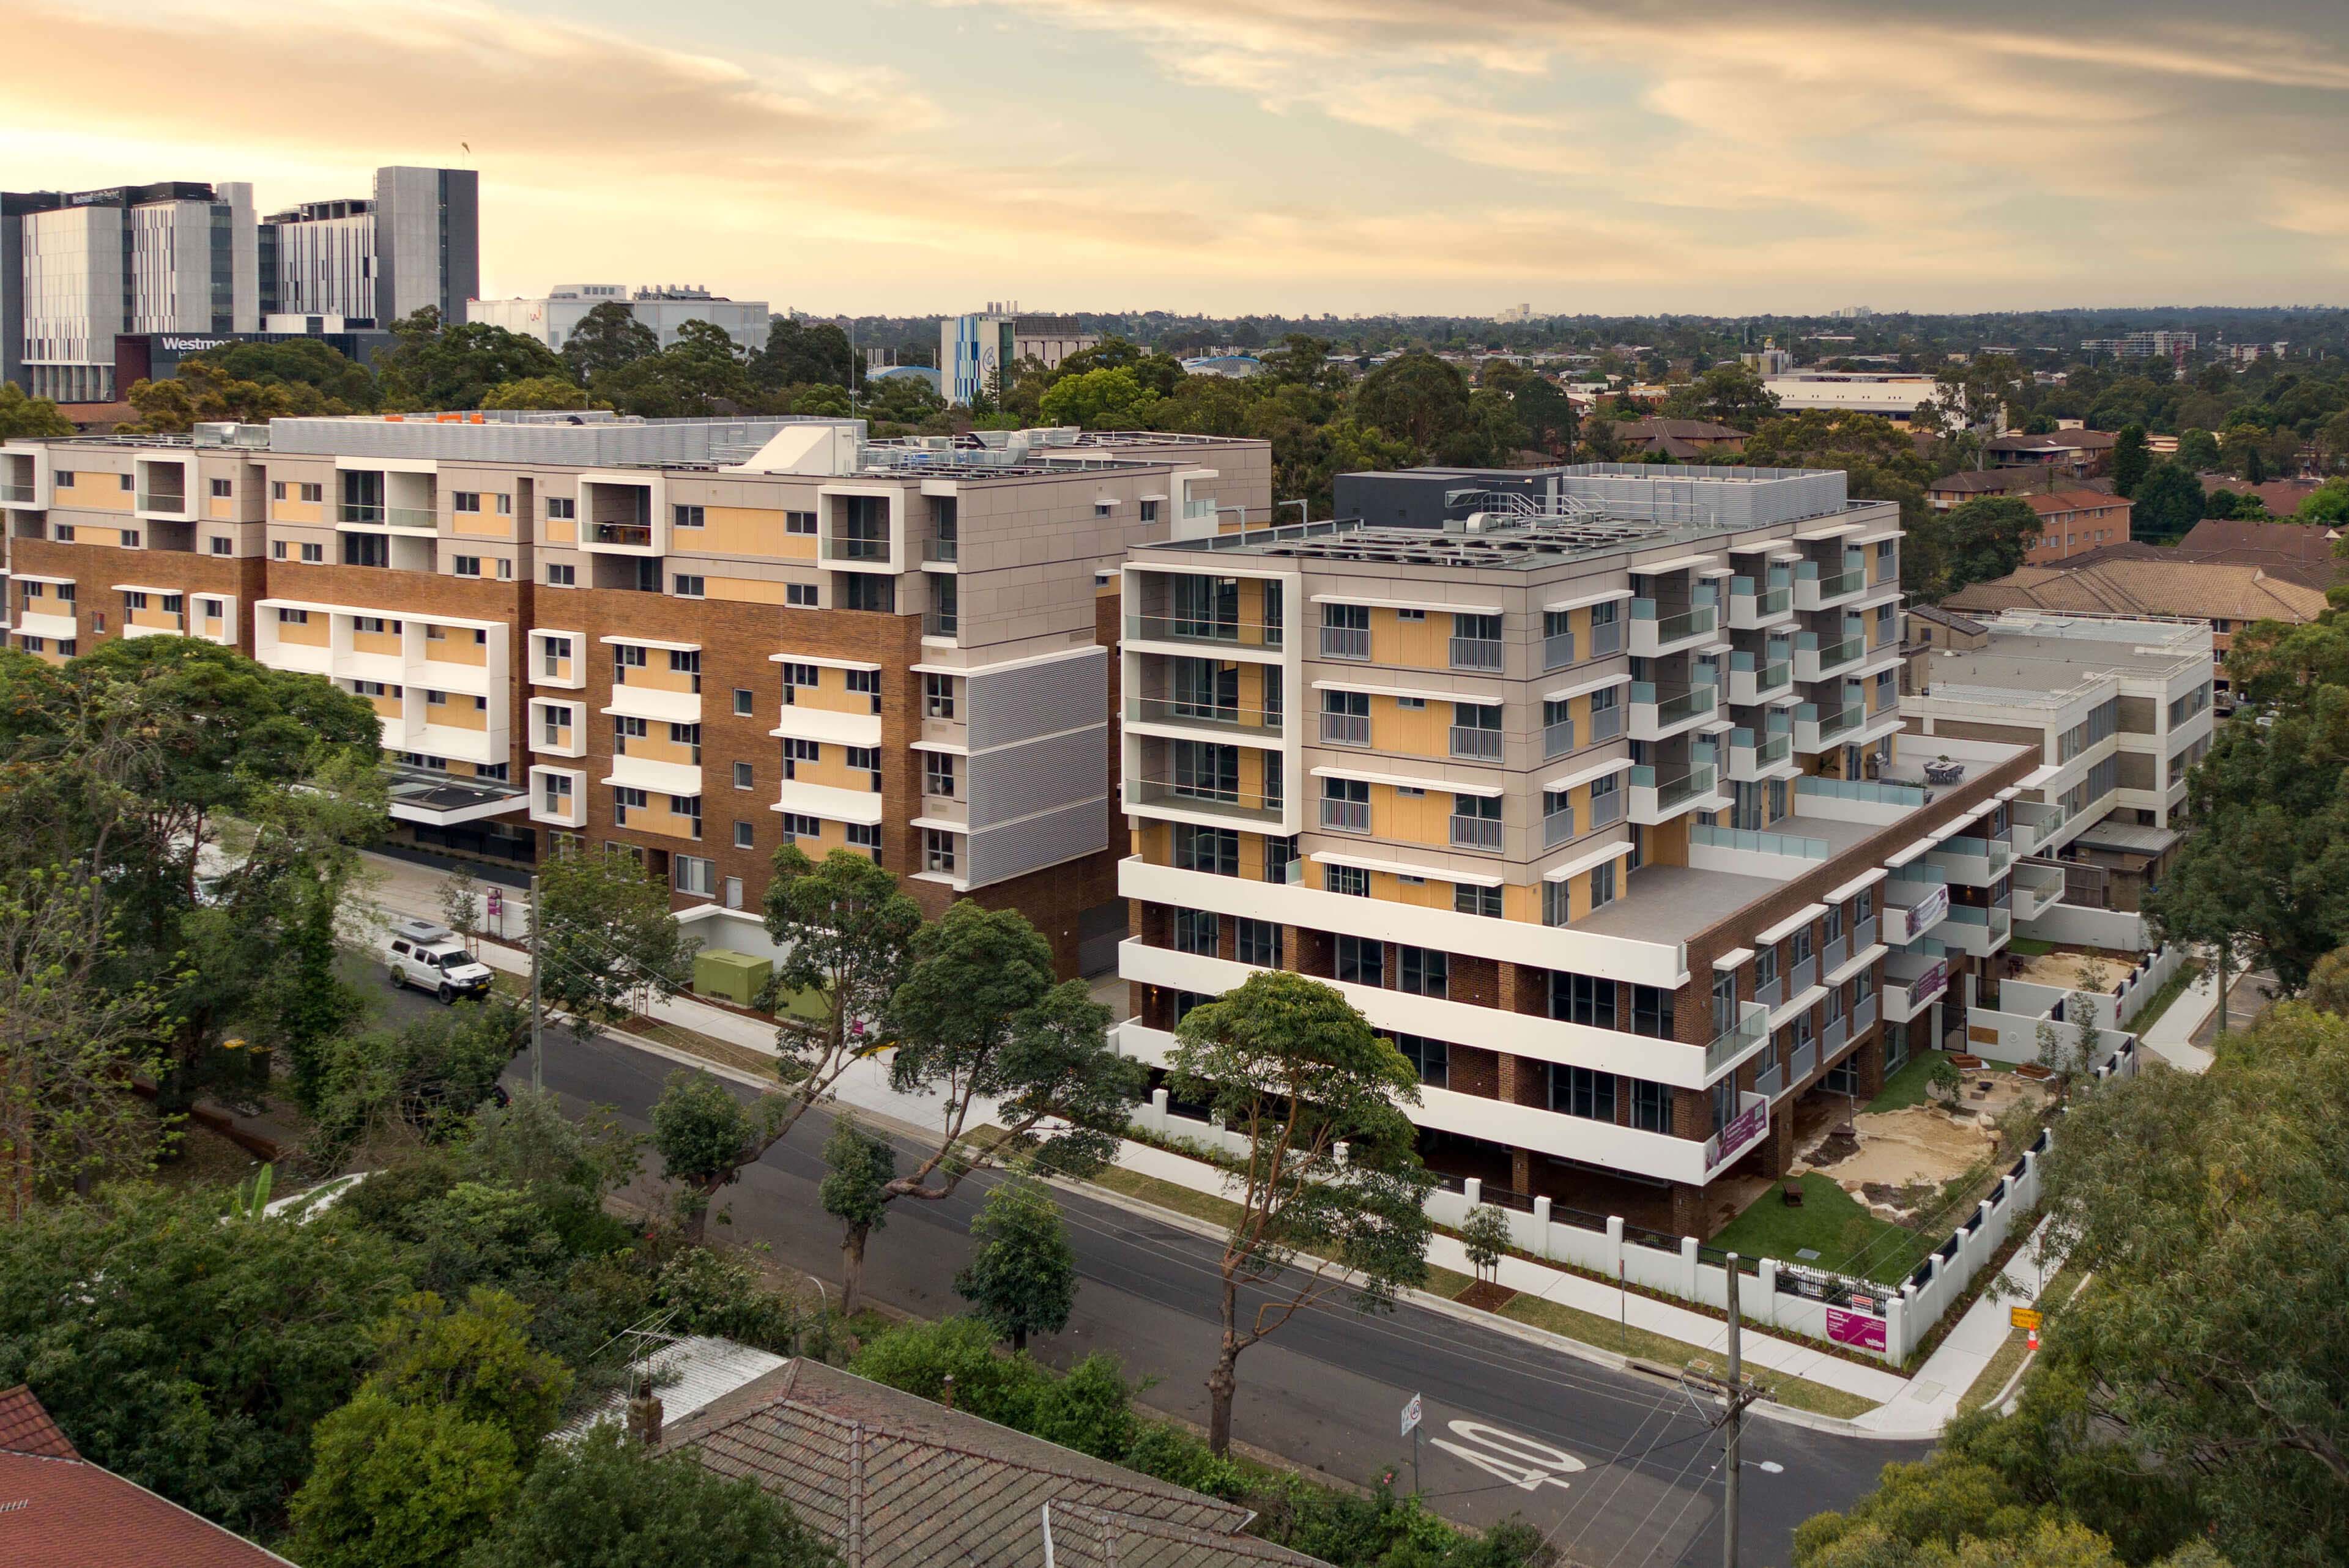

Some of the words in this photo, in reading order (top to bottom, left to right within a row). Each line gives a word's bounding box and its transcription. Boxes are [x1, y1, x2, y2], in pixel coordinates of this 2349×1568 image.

[162, 337, 243, 350] Westme
[1412, 1403, 1420, 1416] 40
[1430, 1420, 1586, 1491] 40
